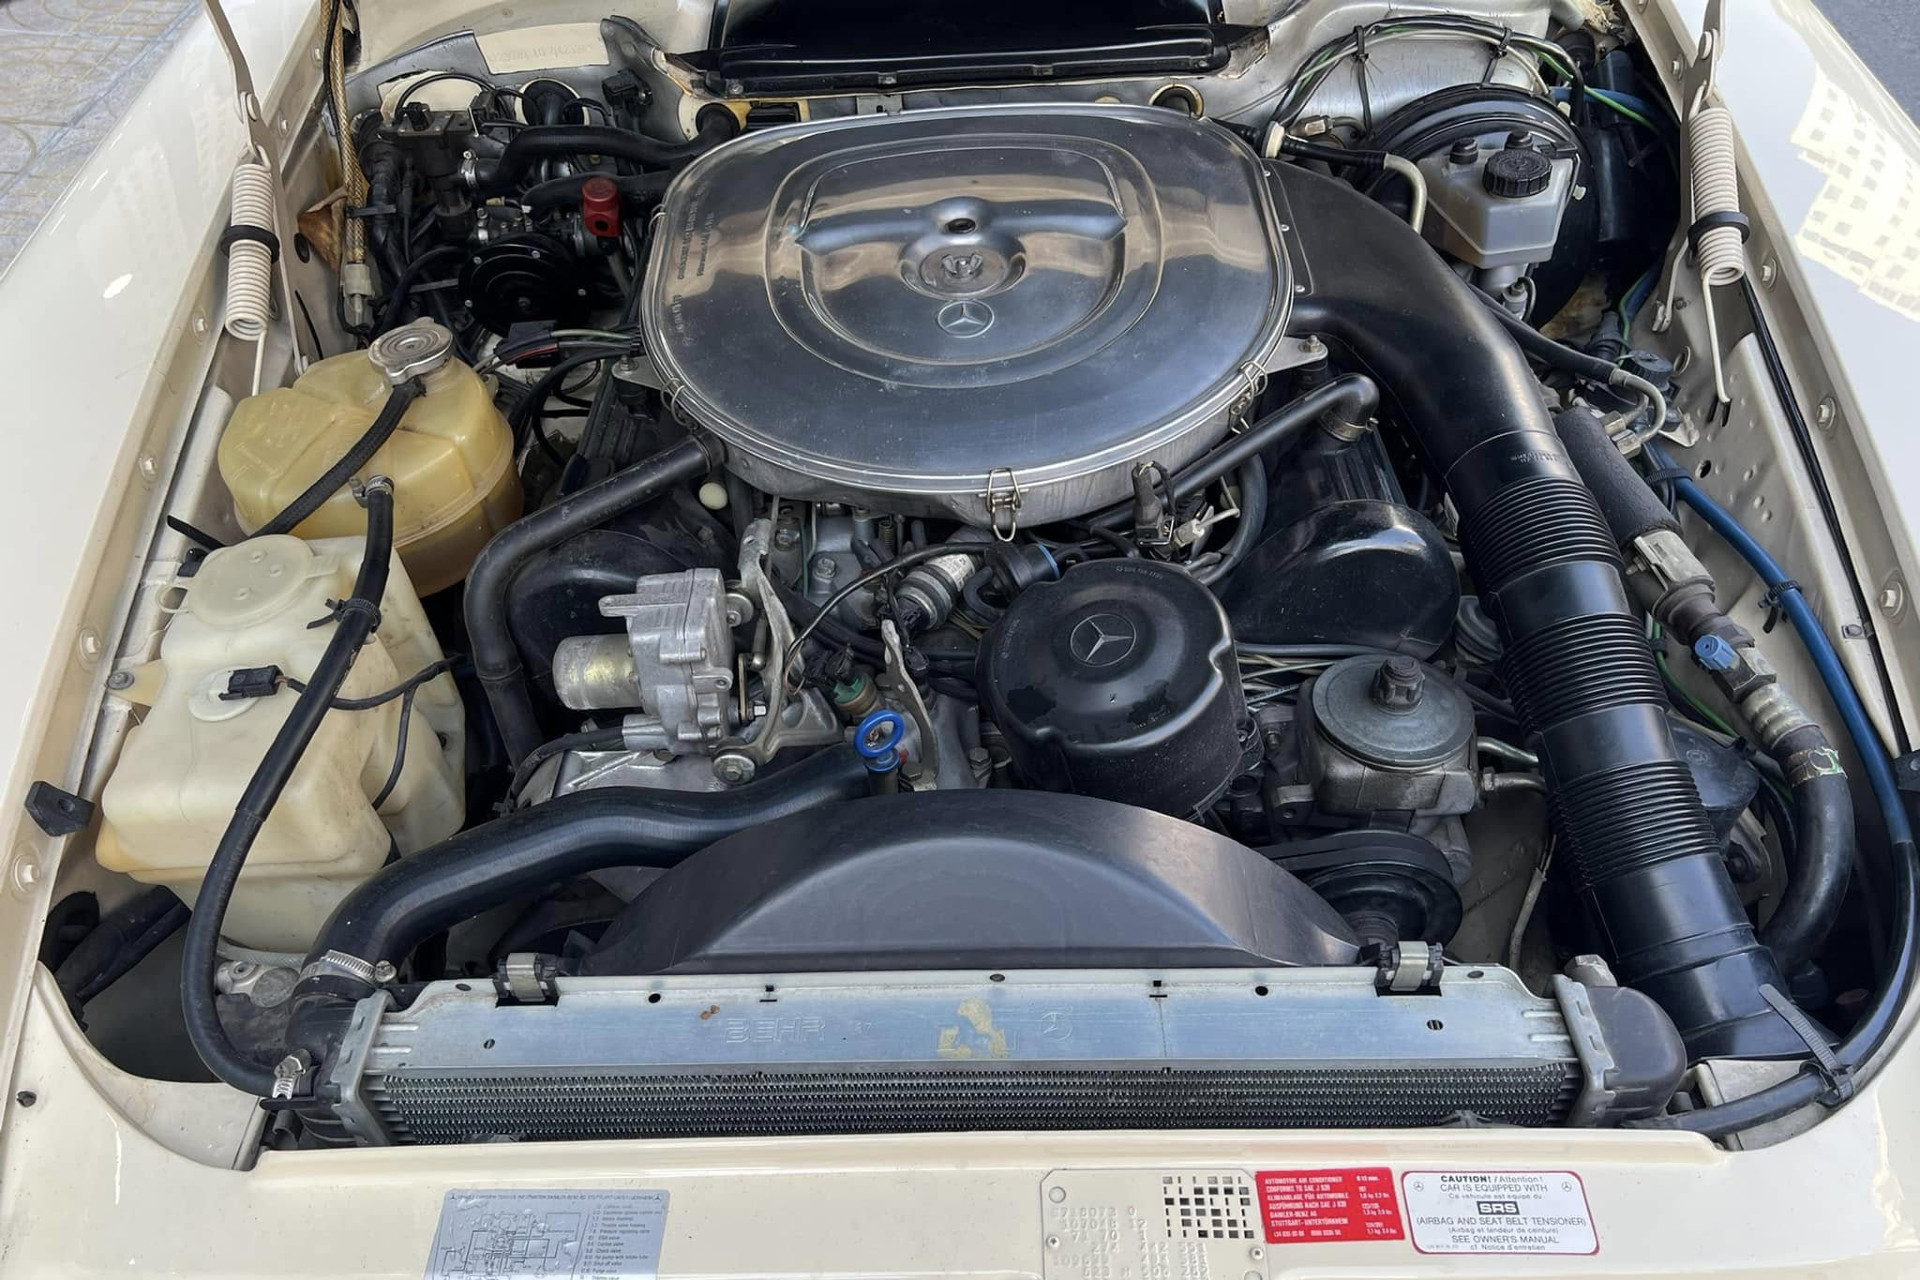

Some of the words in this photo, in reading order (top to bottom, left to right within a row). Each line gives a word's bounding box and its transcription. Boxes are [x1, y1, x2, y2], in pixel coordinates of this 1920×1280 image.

[725, 1016, 825, 1043] BEHR
[1440, 1184, 1460, 1192] CAR
[1462, 1184, 1472, 1192] IS
[1475, 1184, 1521, 1192] EQUIPPED
[1524, 1184, 1548, 1192] WITH
[1479, 1203, 1517, 1213] SRS
[1416, 1217, 1454, 1225] (AIRBAG
[1458, 1217, 1477, 1225] AND
[1479, 1217, 1502, 1225] SEAT
[1506, 1217, 1528, 1226] BELT
[1532, 1217, 1587, 1226] TENSIONER)
[1452, 1235, 1471, 1243] SEE
[1473, 1235, 1517, 1243] OWNER'S
[1520, 1236, 1560, 1244] MANUAL
